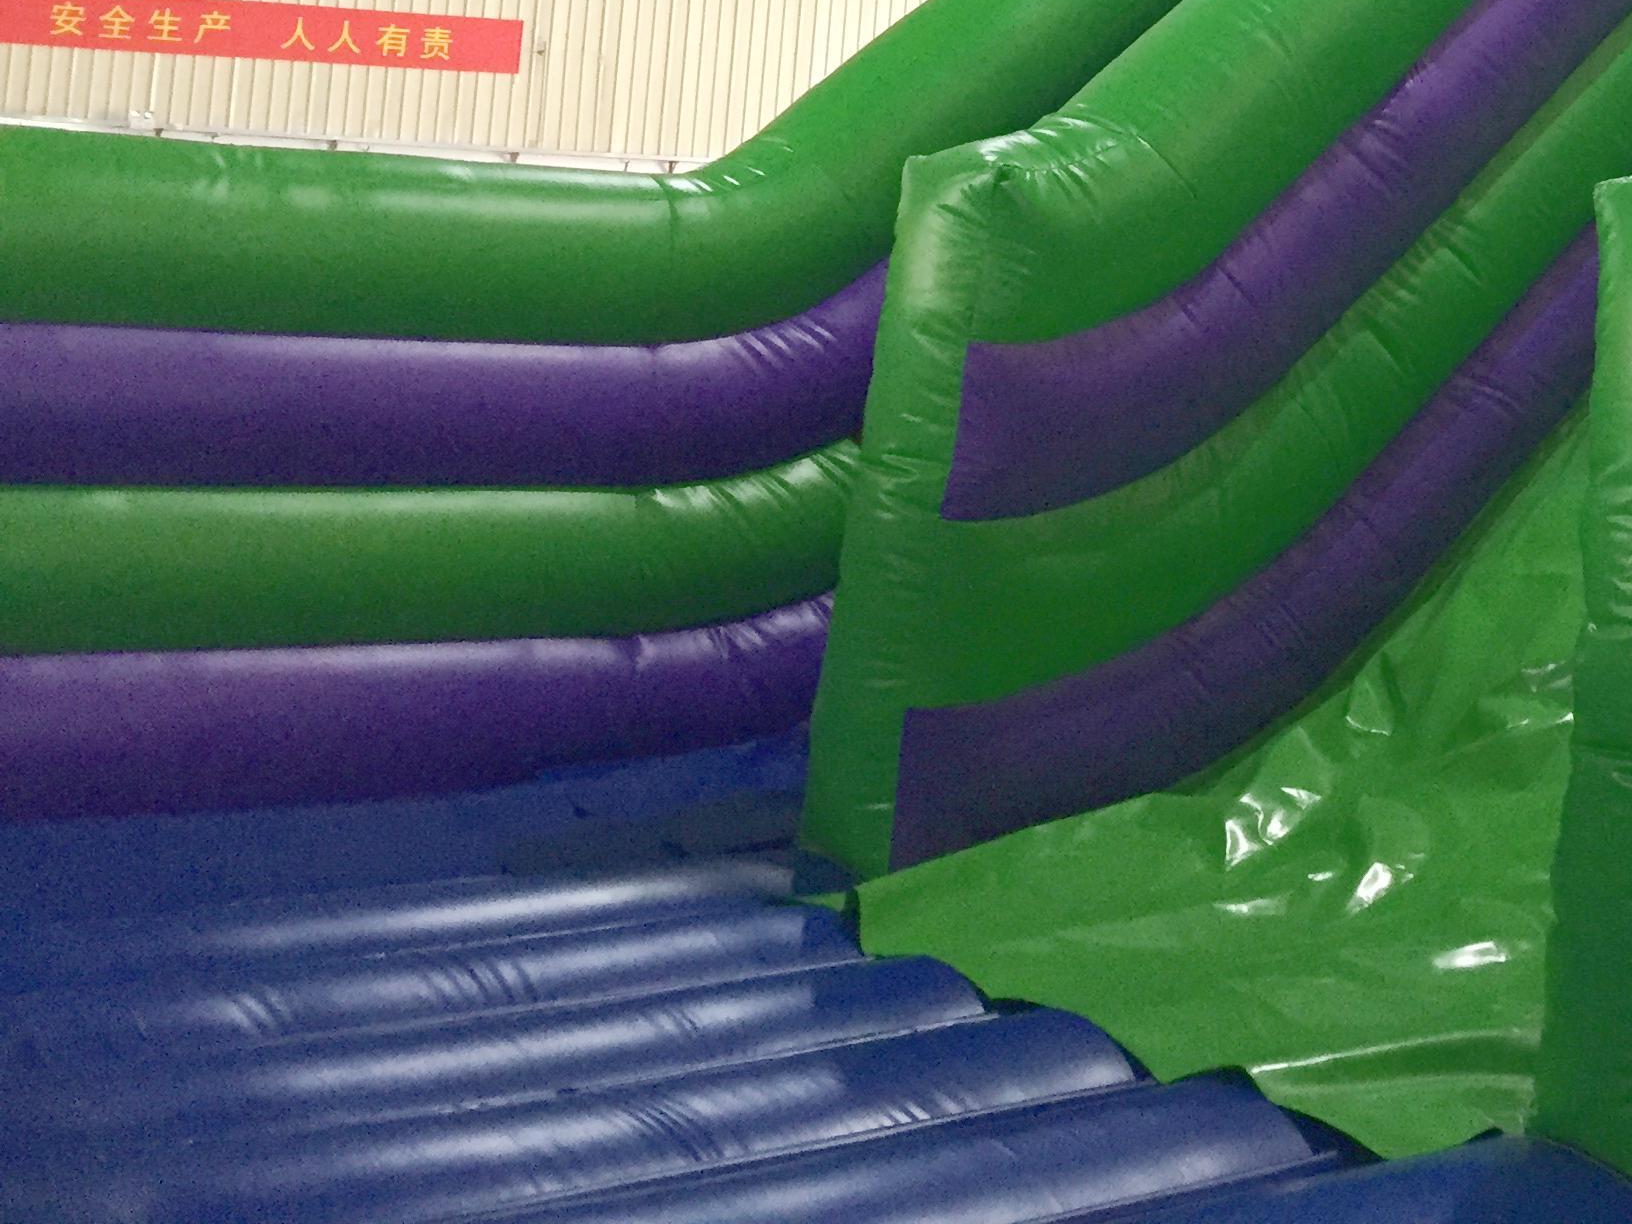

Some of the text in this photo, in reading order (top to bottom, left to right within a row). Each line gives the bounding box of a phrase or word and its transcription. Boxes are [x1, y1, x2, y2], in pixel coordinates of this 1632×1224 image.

[49, 2, 454, 60] 安全生产 人人有责
